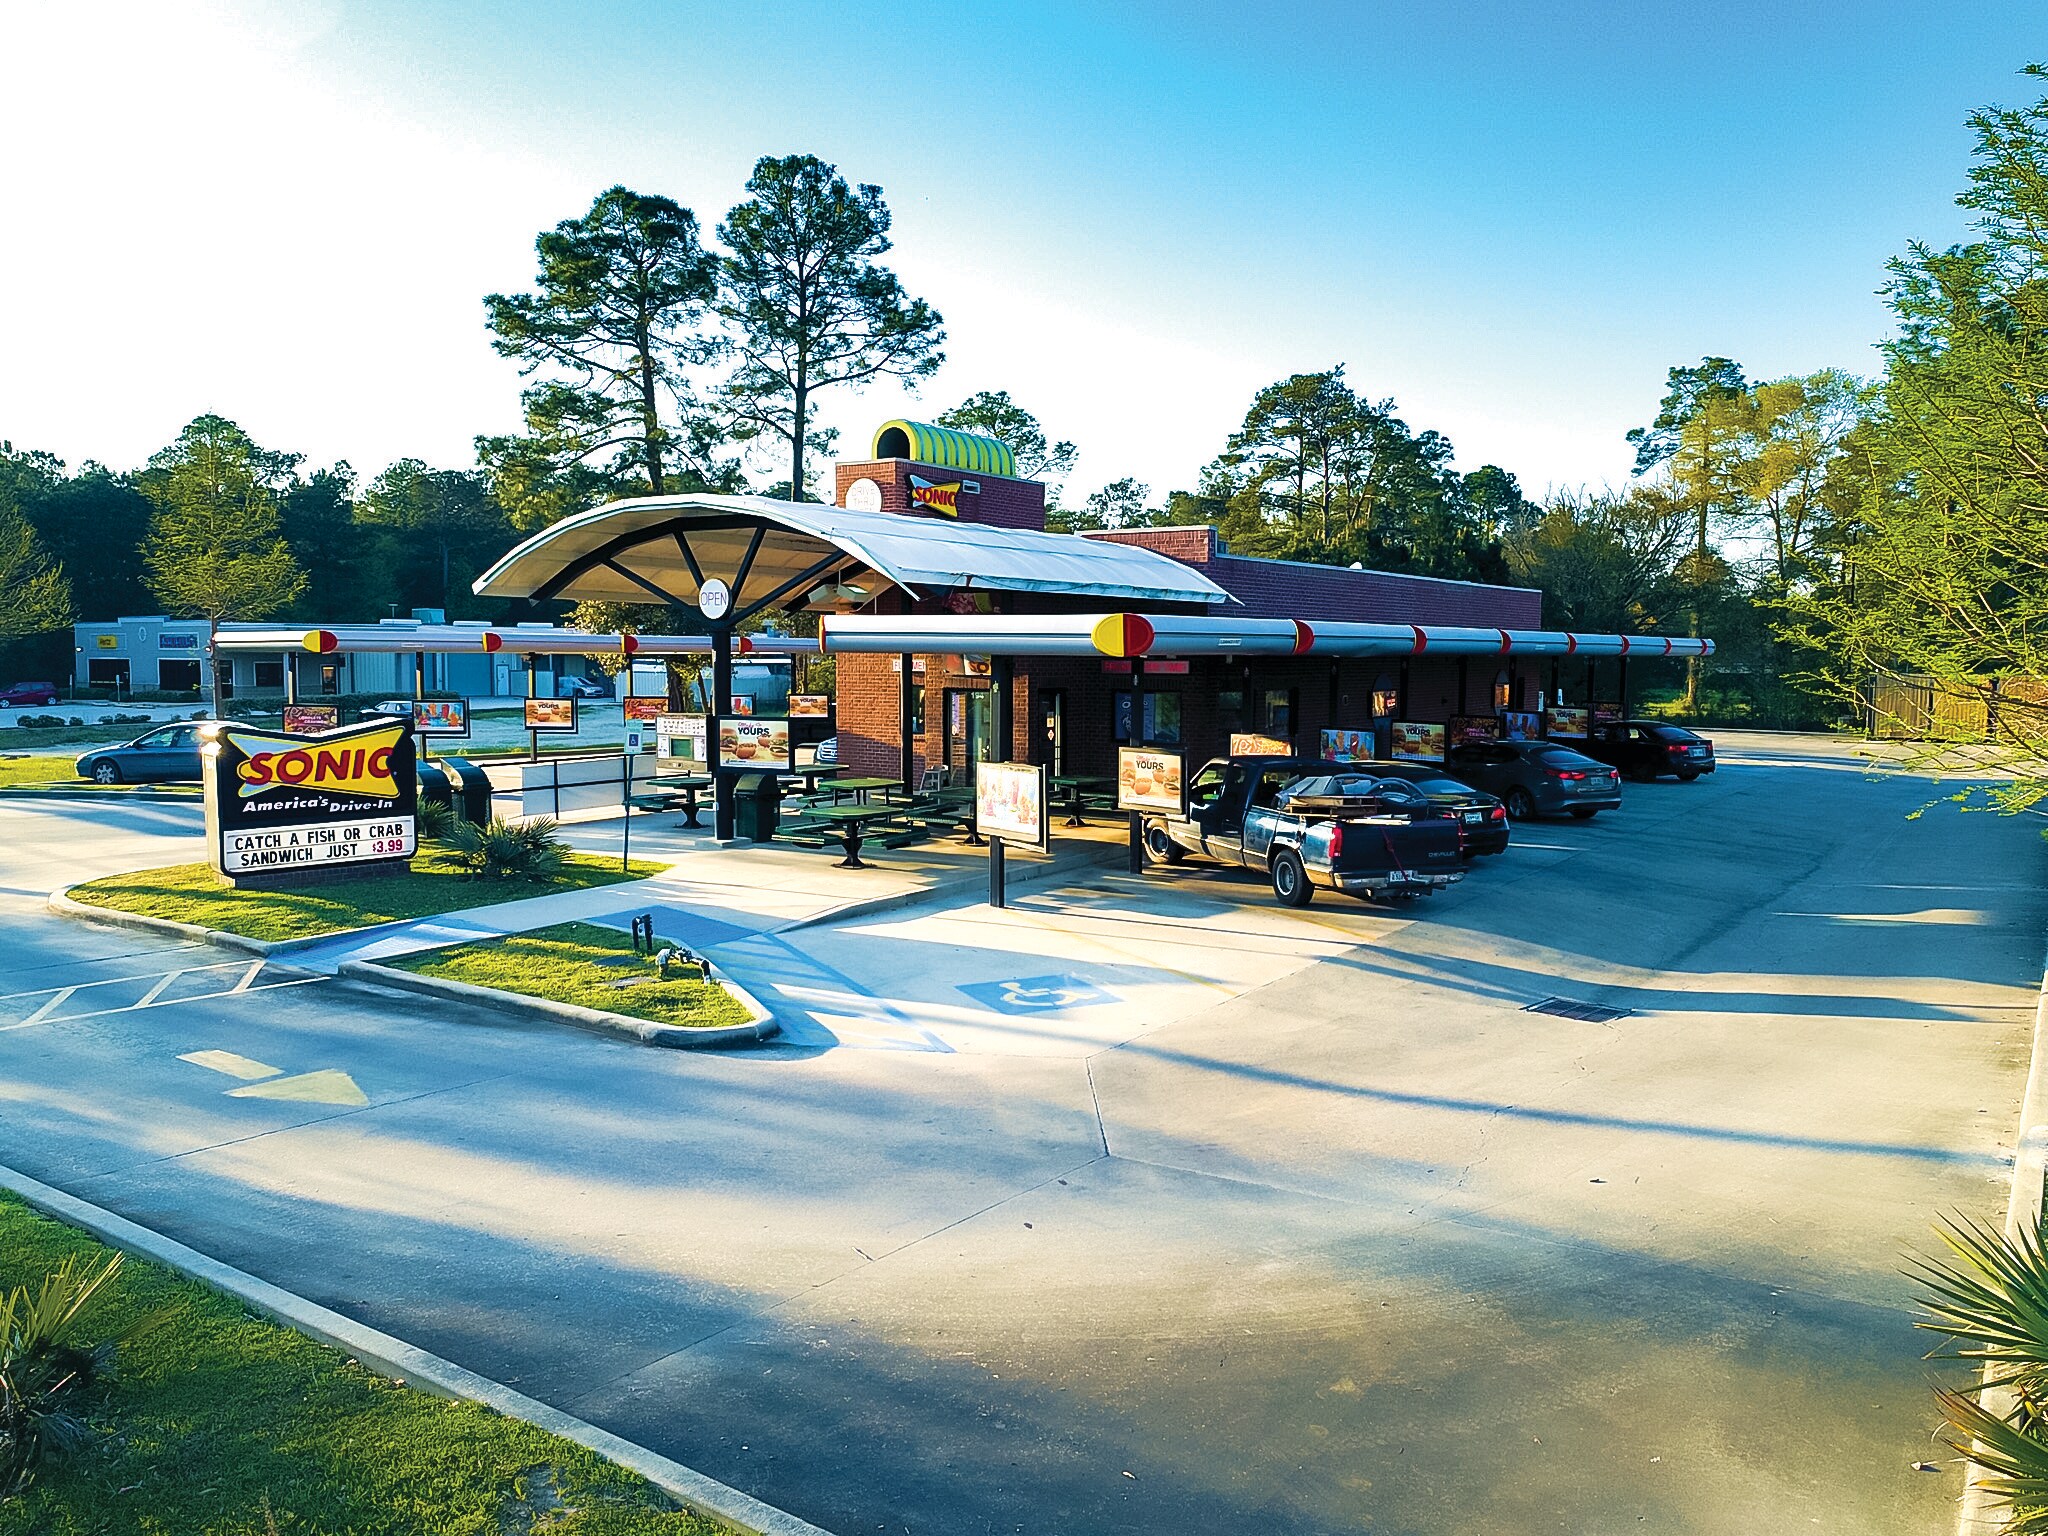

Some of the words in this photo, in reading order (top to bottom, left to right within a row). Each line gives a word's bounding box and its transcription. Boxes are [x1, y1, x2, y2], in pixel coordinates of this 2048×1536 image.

[914, 486, 956, 507] SONIC
[700, 591, 727, 606] OPEN
[737, 727, 770, 736] YOURS
[1405, 727, 1431, 737] YOURS
[245, 747, 394, 786] SONIC
[1135, 760, 1164, 770] YOURS
[242, 795, 329, 813] America's
[329, 799, 393, 813] Drive-In
[234, 833, 282, 851] CATCH
[289, 832, 300, 846] A
[307, 829, 336, 844] FISH
[343, 827, 361, 840] OR
[369, 823, 404, 838] CRAB
[240, 847, 313, 867] SANDWICH
[326, 843, 358, 859] JUST
[372, 838, 403, 853] $3.99
